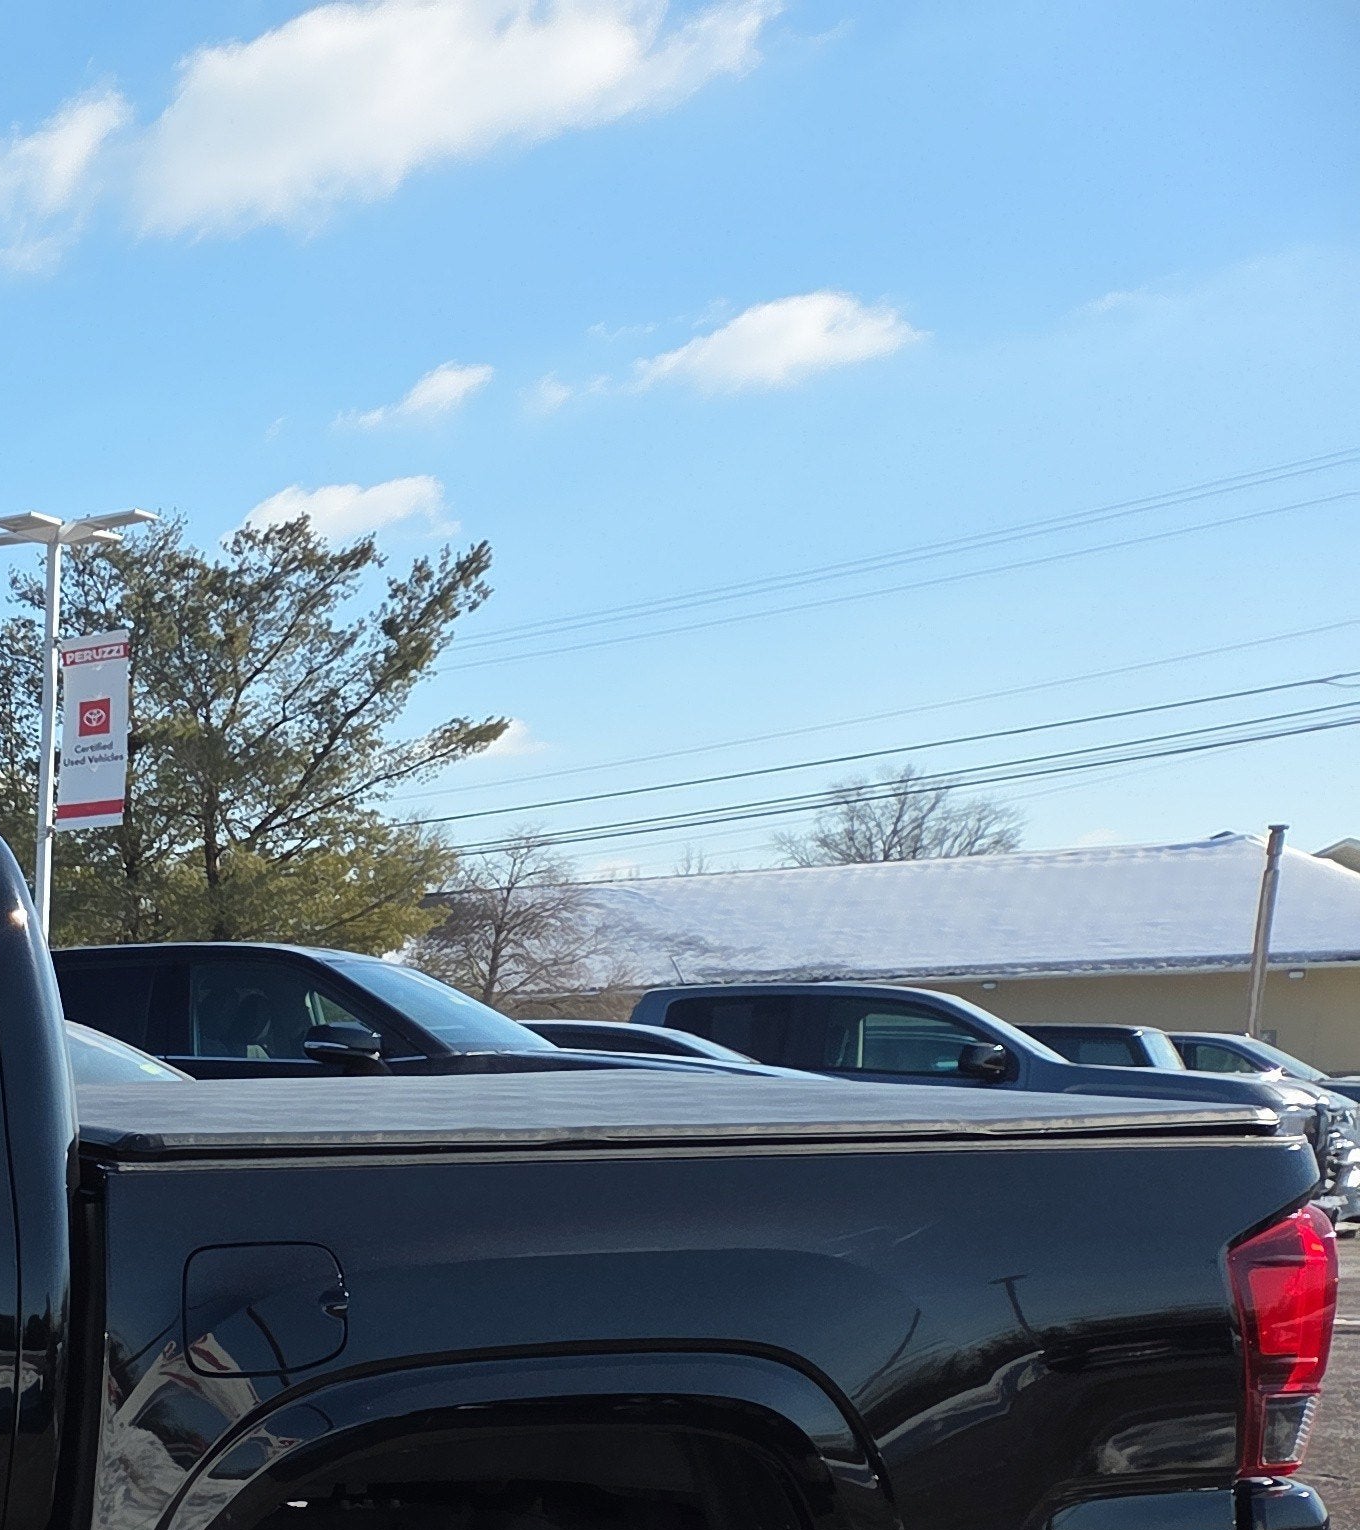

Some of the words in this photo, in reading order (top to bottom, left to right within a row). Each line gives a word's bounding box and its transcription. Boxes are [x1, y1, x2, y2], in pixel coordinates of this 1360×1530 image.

[65, 644, 125, 665] PERUZZI
[74, 740, 114, 754] Certified
[63, 756, 86, 768] Used
[87, 753, 124, 765] Vehicles
